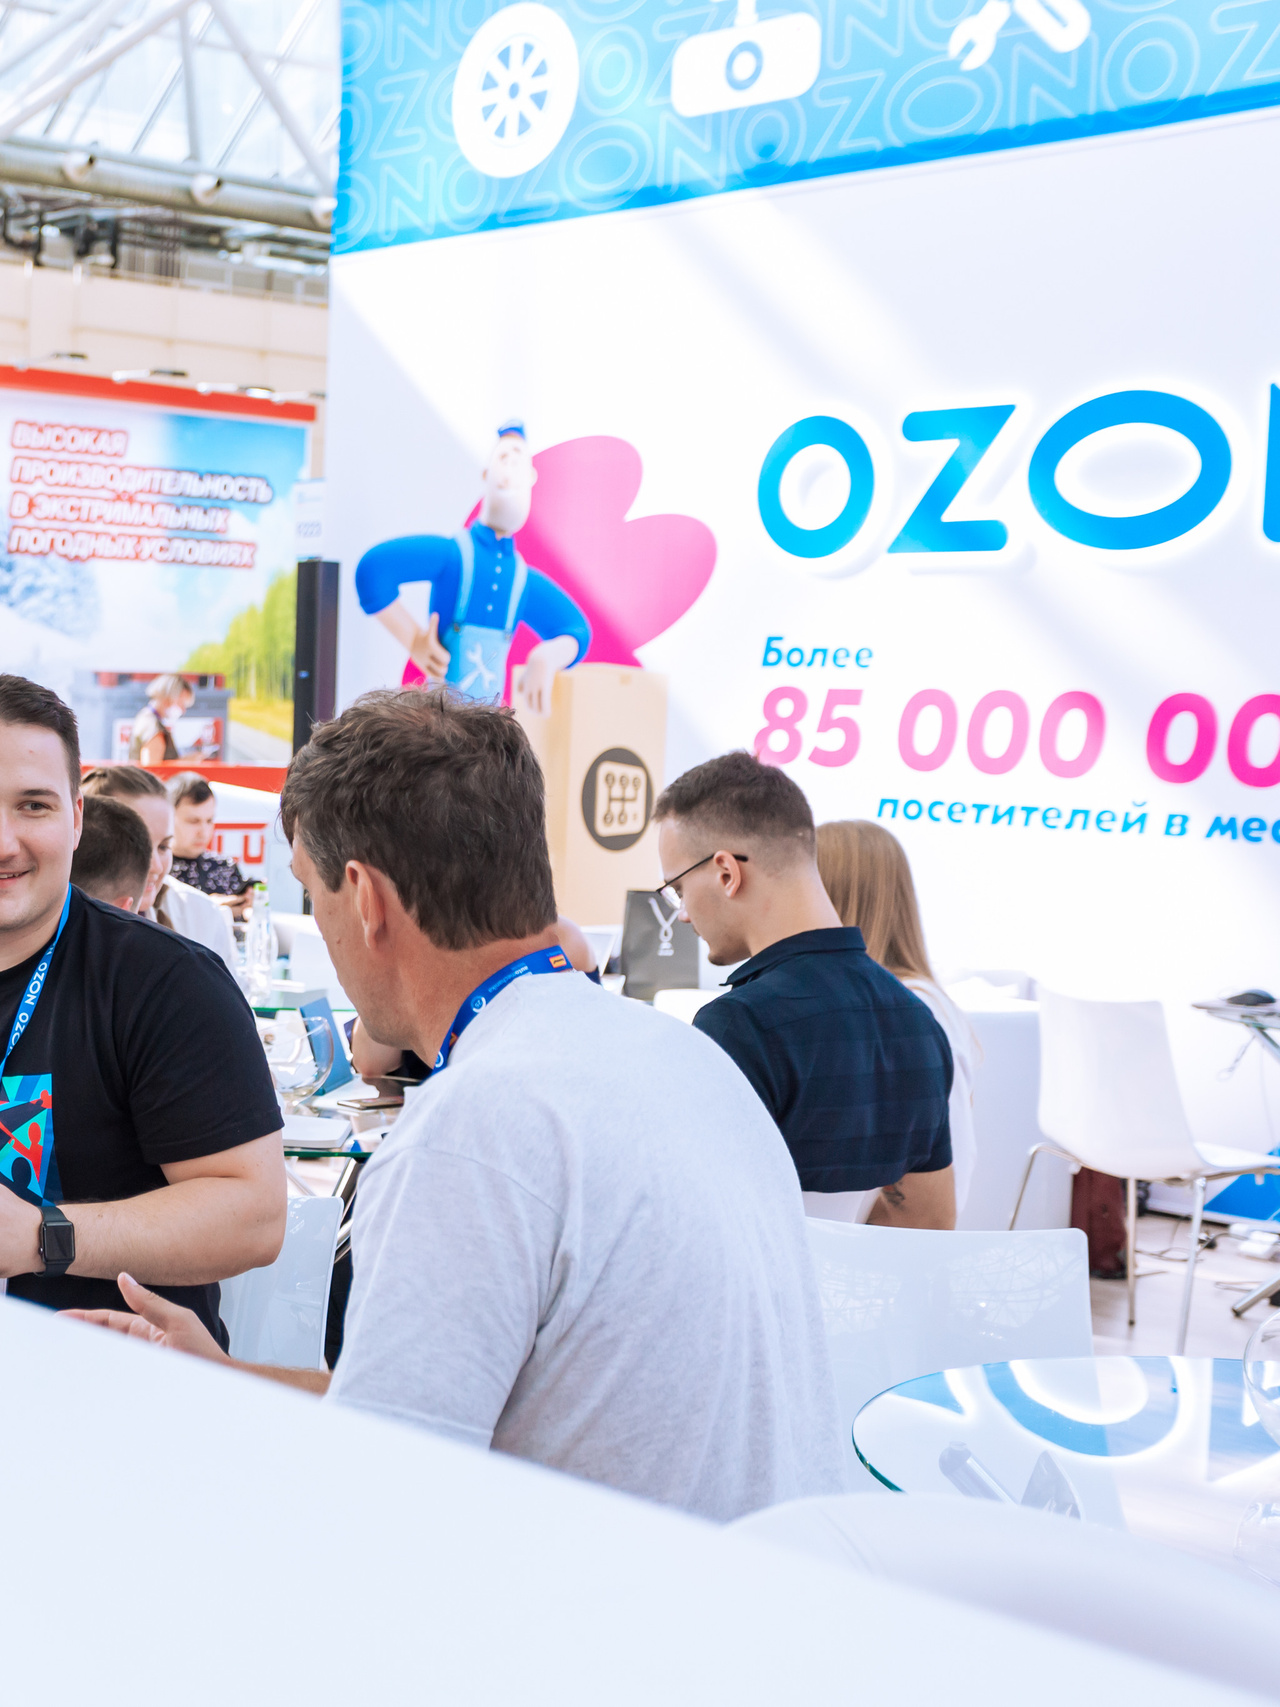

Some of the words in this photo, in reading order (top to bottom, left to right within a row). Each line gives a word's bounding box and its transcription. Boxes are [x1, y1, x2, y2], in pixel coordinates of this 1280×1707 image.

[13, 422, 126, 456] ВЫСОКАЯ
[12, 458, 272, 503] ПРОИЗВОДИТЕЛЬНОСТЬ
[758, 382, 1280, 558] OZO
[11, 493, 28, 517] В
[32, 496, 230, 533] ЭКСТРИМАЛЬНЫХ
[9, 528, 139, 561] ПОГОДНЫХ
[138, 541, 255, 568] УСЛОВИЯХ
[762, 636, 873, 668] Более
[754, 686, 863, 768] 85
[898, 688, 1106, 779] 000
[877, 799, 1148, 835] посетителей
[1164, 813, 1190, 836] в
[25, 962, 48, 1005] OZON
[6, 1012, 29, 1055] OZO
